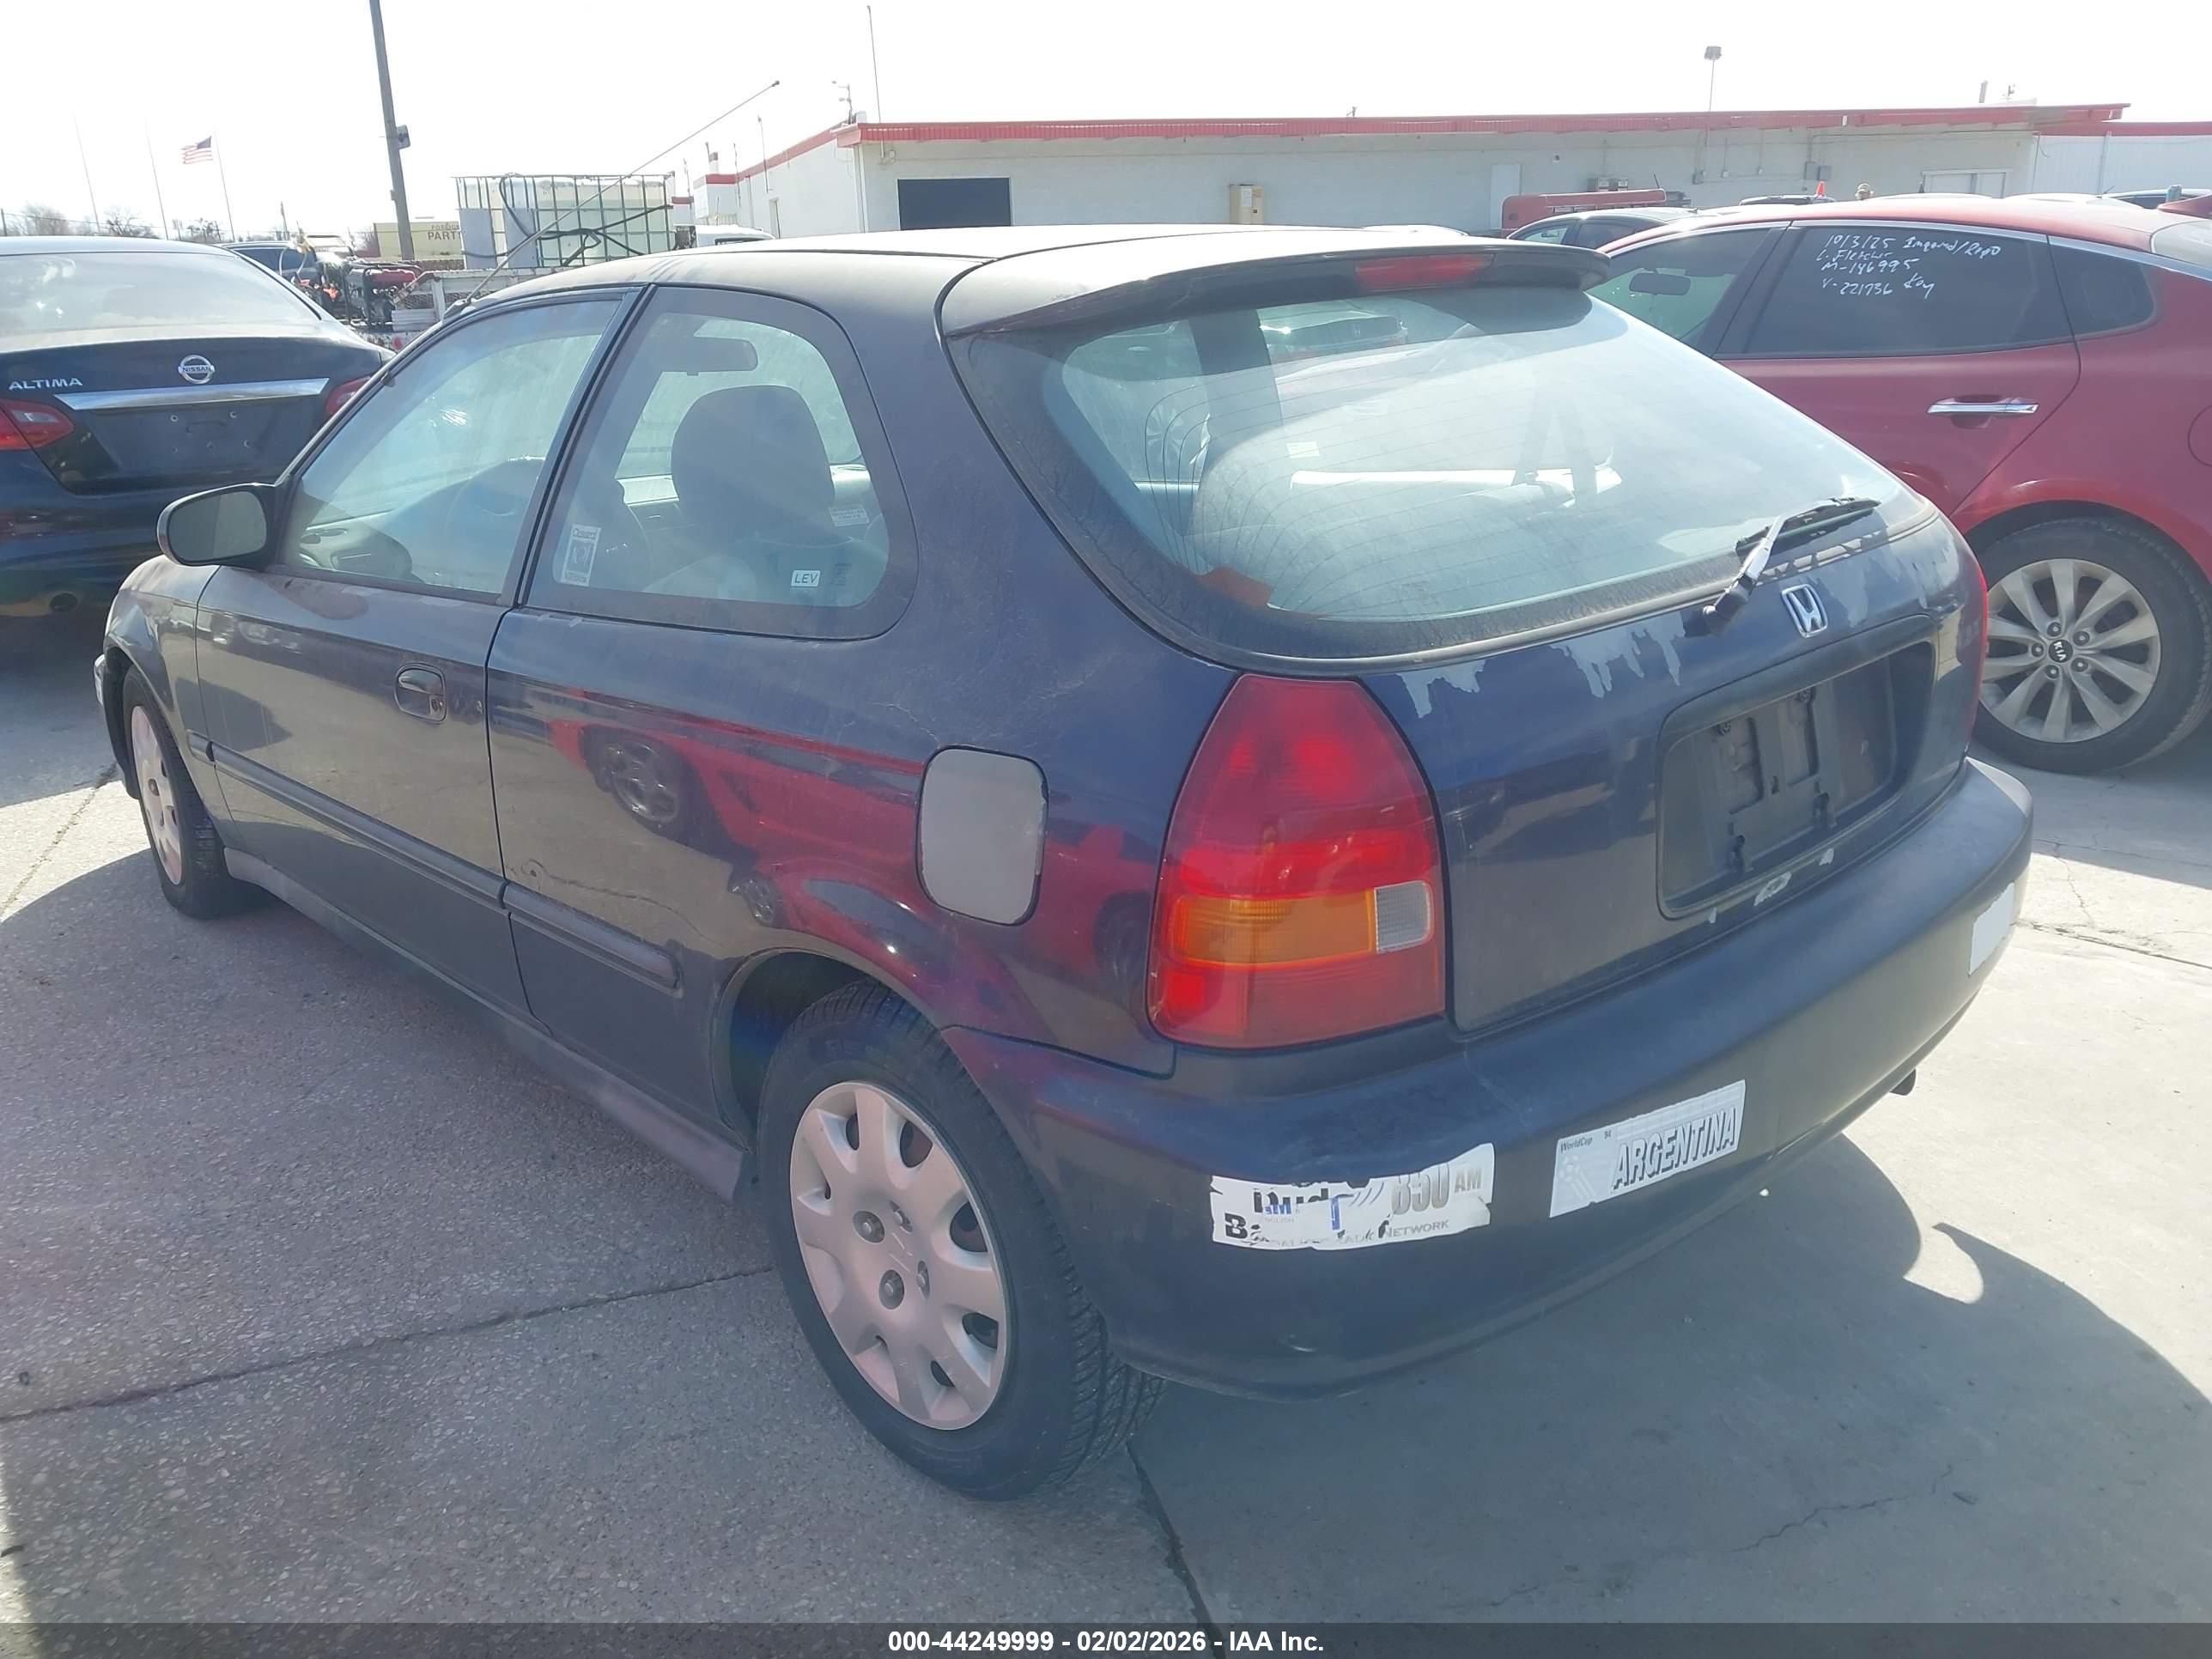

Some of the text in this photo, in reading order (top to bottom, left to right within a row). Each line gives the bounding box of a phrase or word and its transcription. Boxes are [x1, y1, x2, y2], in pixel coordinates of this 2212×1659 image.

[1825, 235, 1897, 249] 10/3/25
[9, 377, 83, 390] ALTIMA
[794, 573, 818, 584] LEV
[2053, 641, 2067, 661] KIA
[1613, 1106, 1737, 1190] ARGENTINA
[1454, 1166, 1483, 1194] AM
[1385, 1218, 1450, 1238] NETWORK
